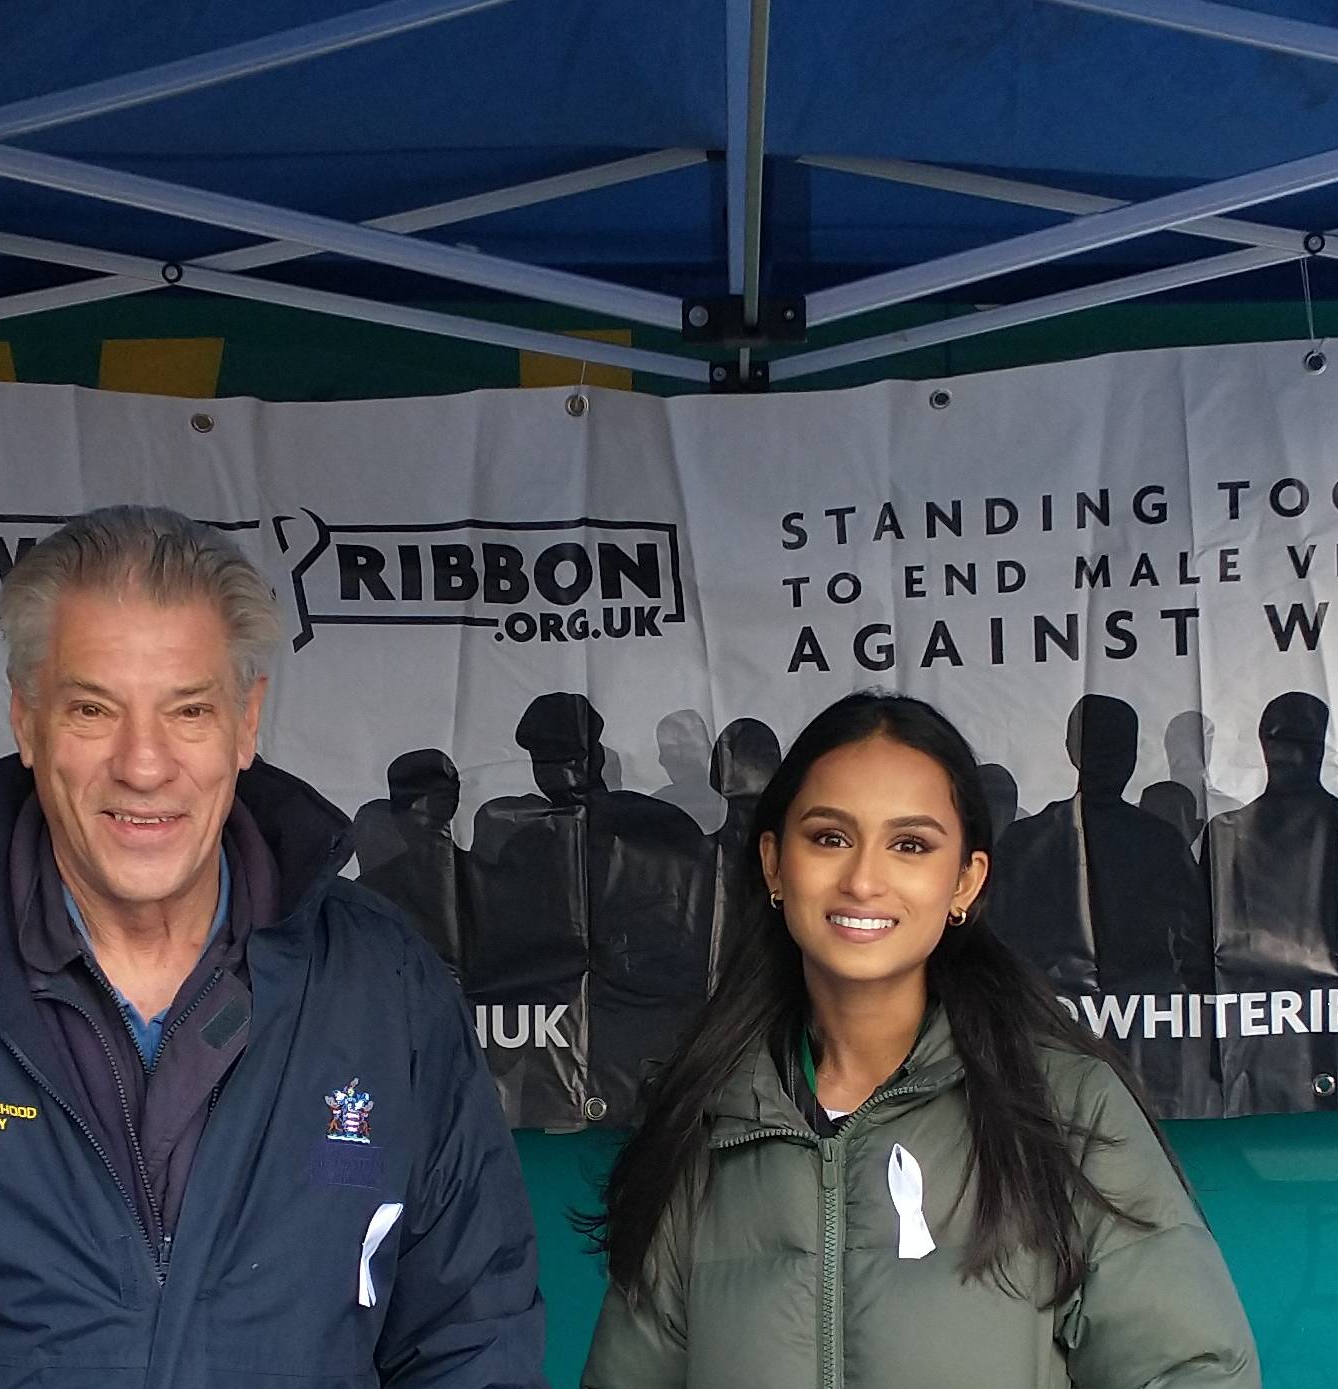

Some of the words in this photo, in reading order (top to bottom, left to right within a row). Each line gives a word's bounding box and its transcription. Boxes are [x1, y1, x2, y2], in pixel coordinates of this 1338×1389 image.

[780, 485, 1171, 551] STANDING
[335, 543, 661, 605] RIBBON
[782, 572, 863, 609] TO
[905, 558, 1027, 599] END
[1074, 547, 1242, 590] MALE
[494, 606, 663, 642] .ORG.UK
[787, 607, 1199, 674] AGAINST
